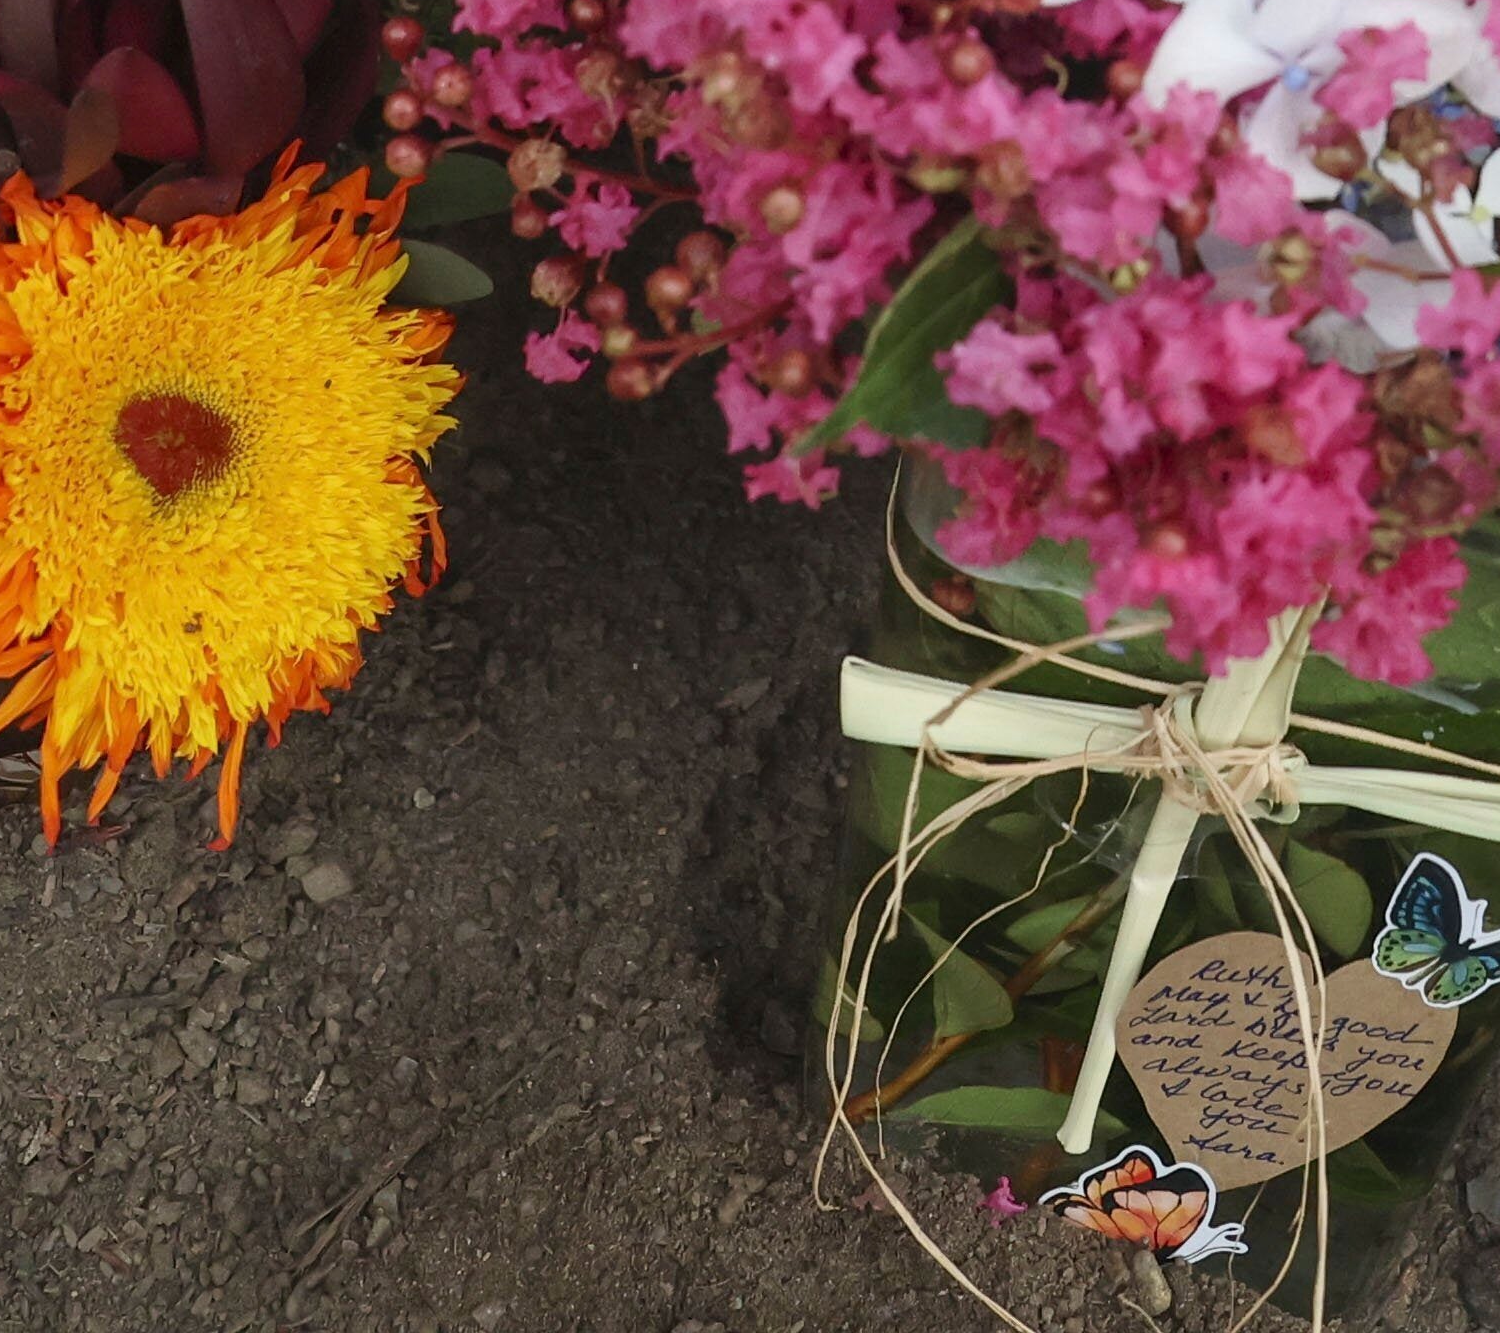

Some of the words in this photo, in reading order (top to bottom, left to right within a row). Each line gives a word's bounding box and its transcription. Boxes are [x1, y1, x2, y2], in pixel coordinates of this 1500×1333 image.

[1129, 1004, 1236, 1029] Lord
[1345, 1046, 1425, 1073] you
[1147, 985, 1231, 1015] May
[1325, 1016, 1435, 1045] good
[1130, 1033, 1204, 1049] and
[1321, 1071, 1418, 1098] you
[1199, 1081, 1300, 1121] love
